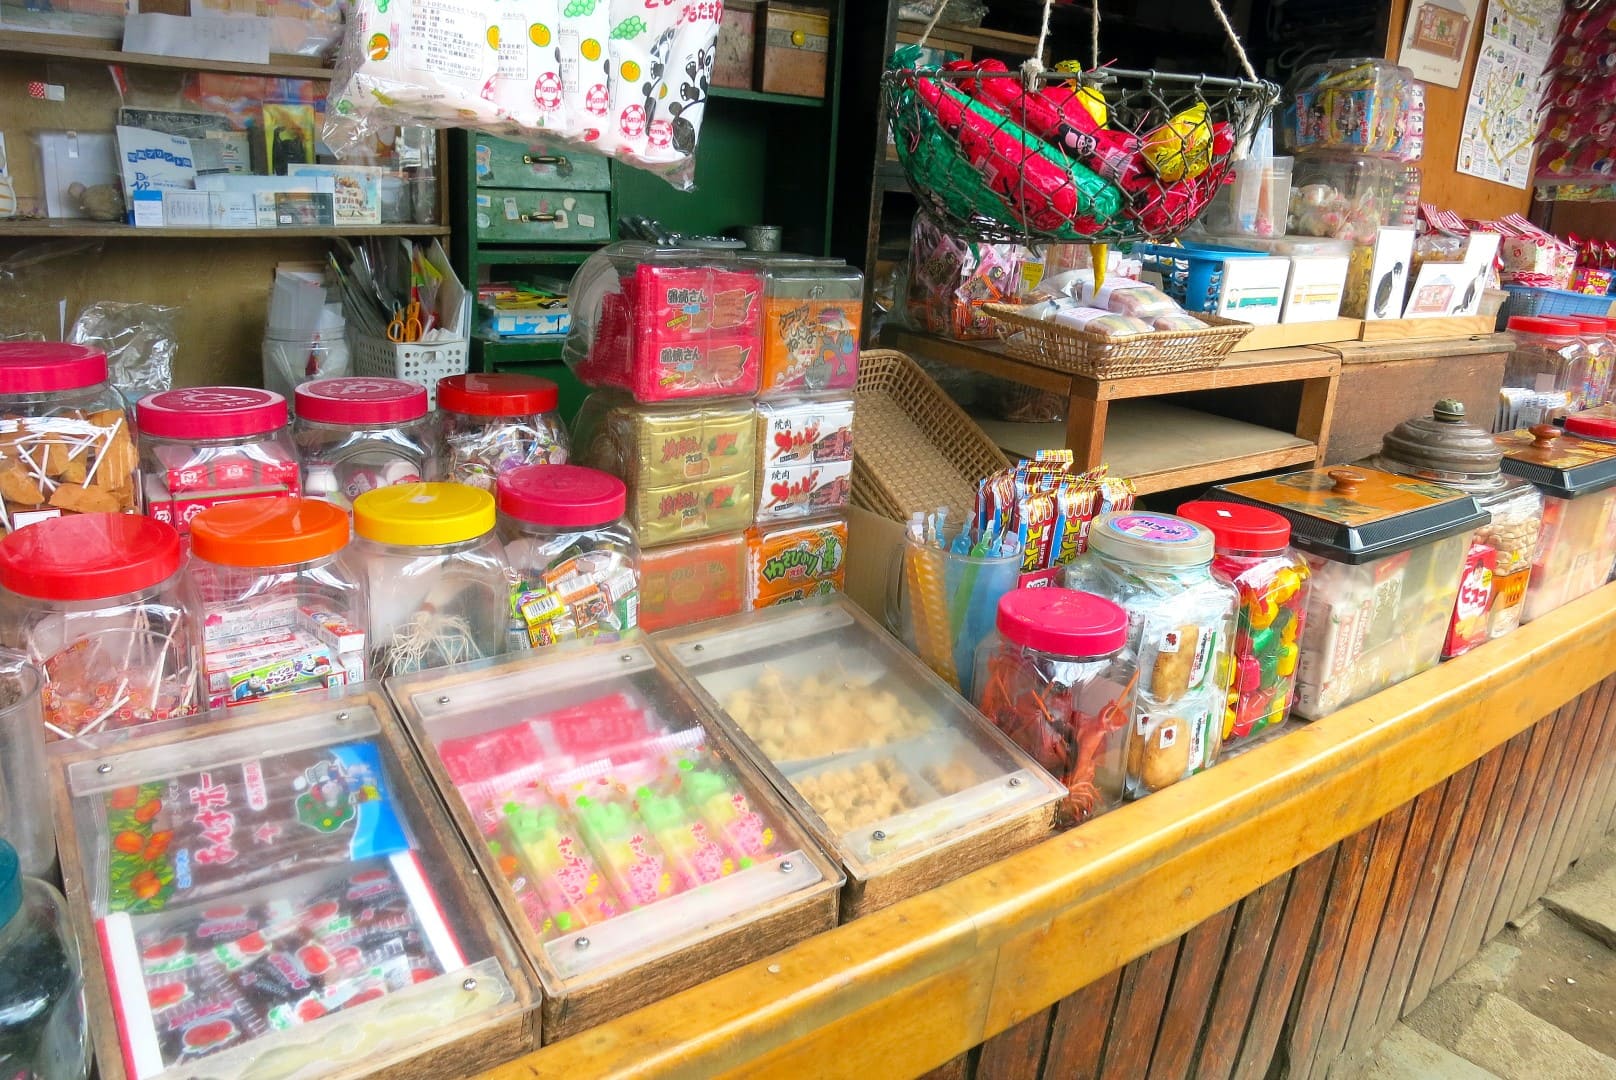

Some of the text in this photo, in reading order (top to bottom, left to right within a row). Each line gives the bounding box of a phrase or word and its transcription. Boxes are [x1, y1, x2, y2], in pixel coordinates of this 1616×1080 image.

[762, 548, 820, 582] わさびのり
[1461, 585, 1488, 608] ビスコ
[190, 771, 238, 866] あんずボー
